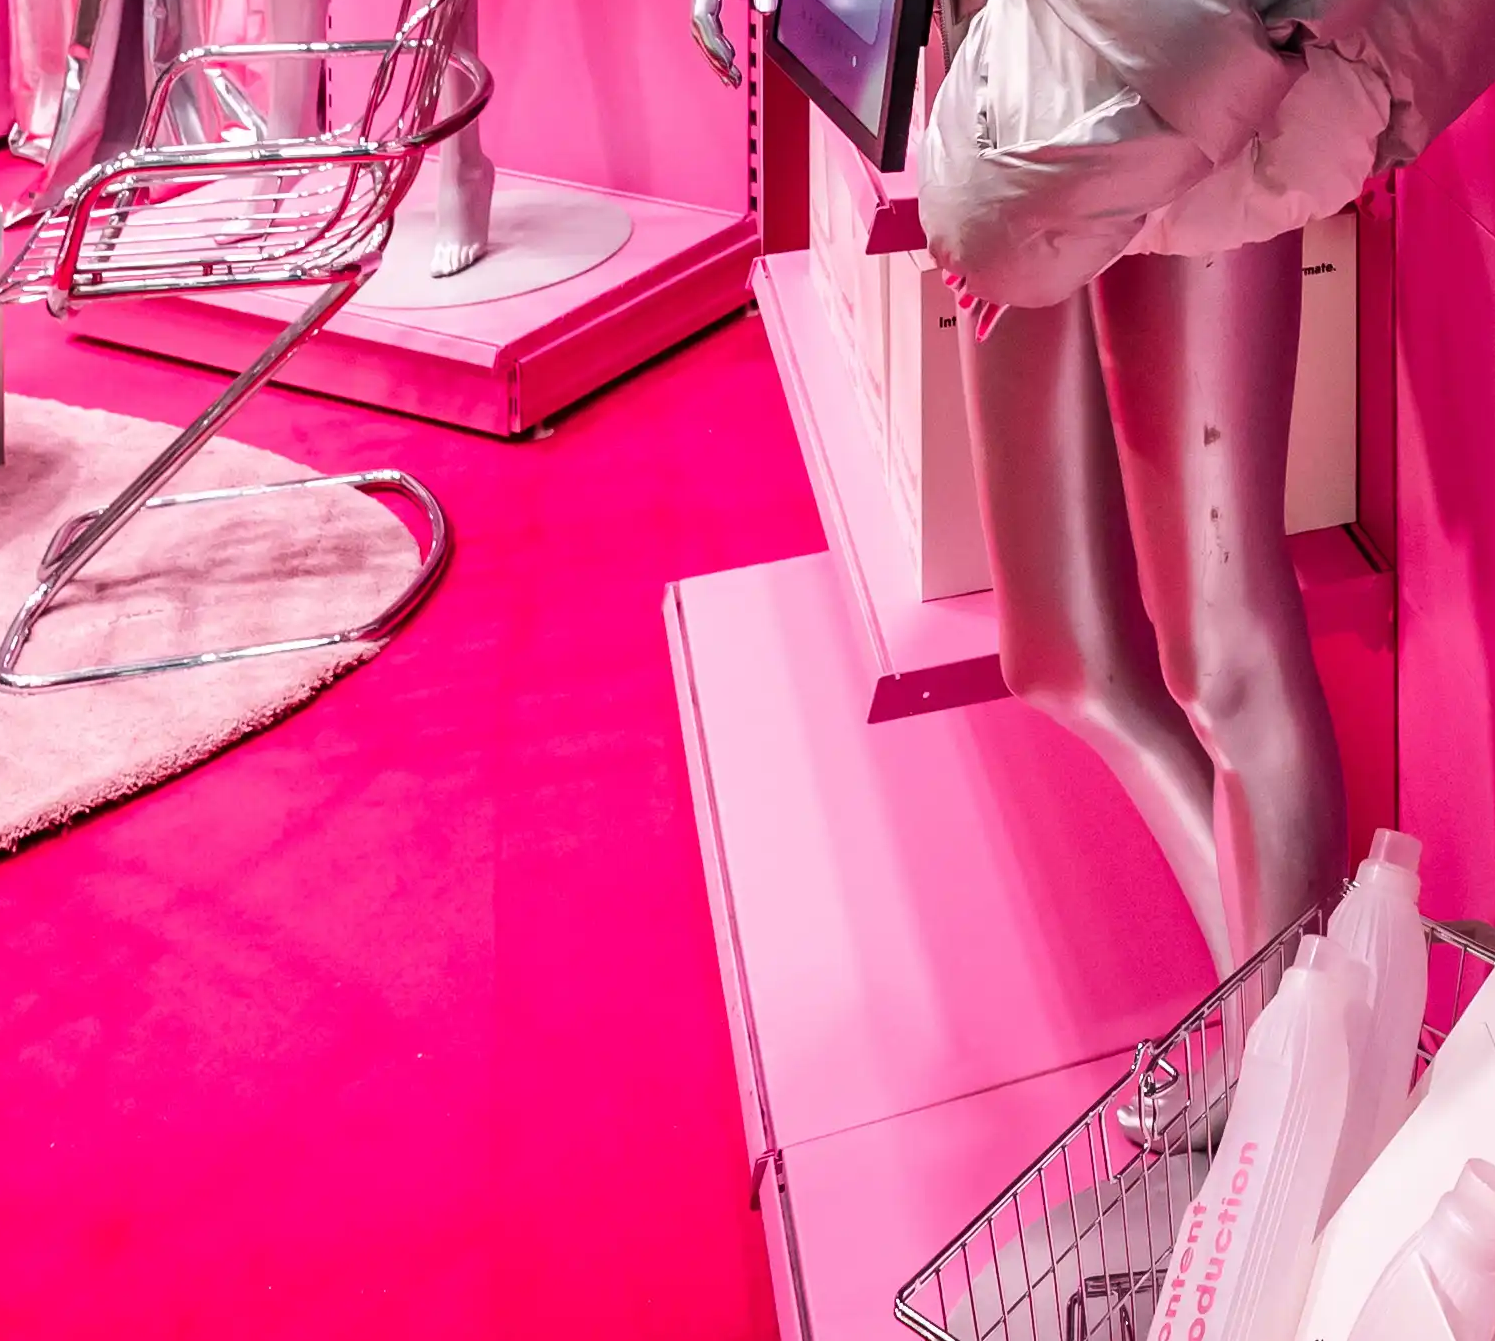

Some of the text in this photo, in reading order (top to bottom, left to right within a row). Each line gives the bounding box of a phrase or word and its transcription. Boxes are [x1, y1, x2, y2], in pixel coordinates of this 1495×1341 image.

[1302, 260, 1337, 277] mate.
[1158, 1202, 1207, 1341] ontent
[1188, 1142, 1258, 1341] oduction
